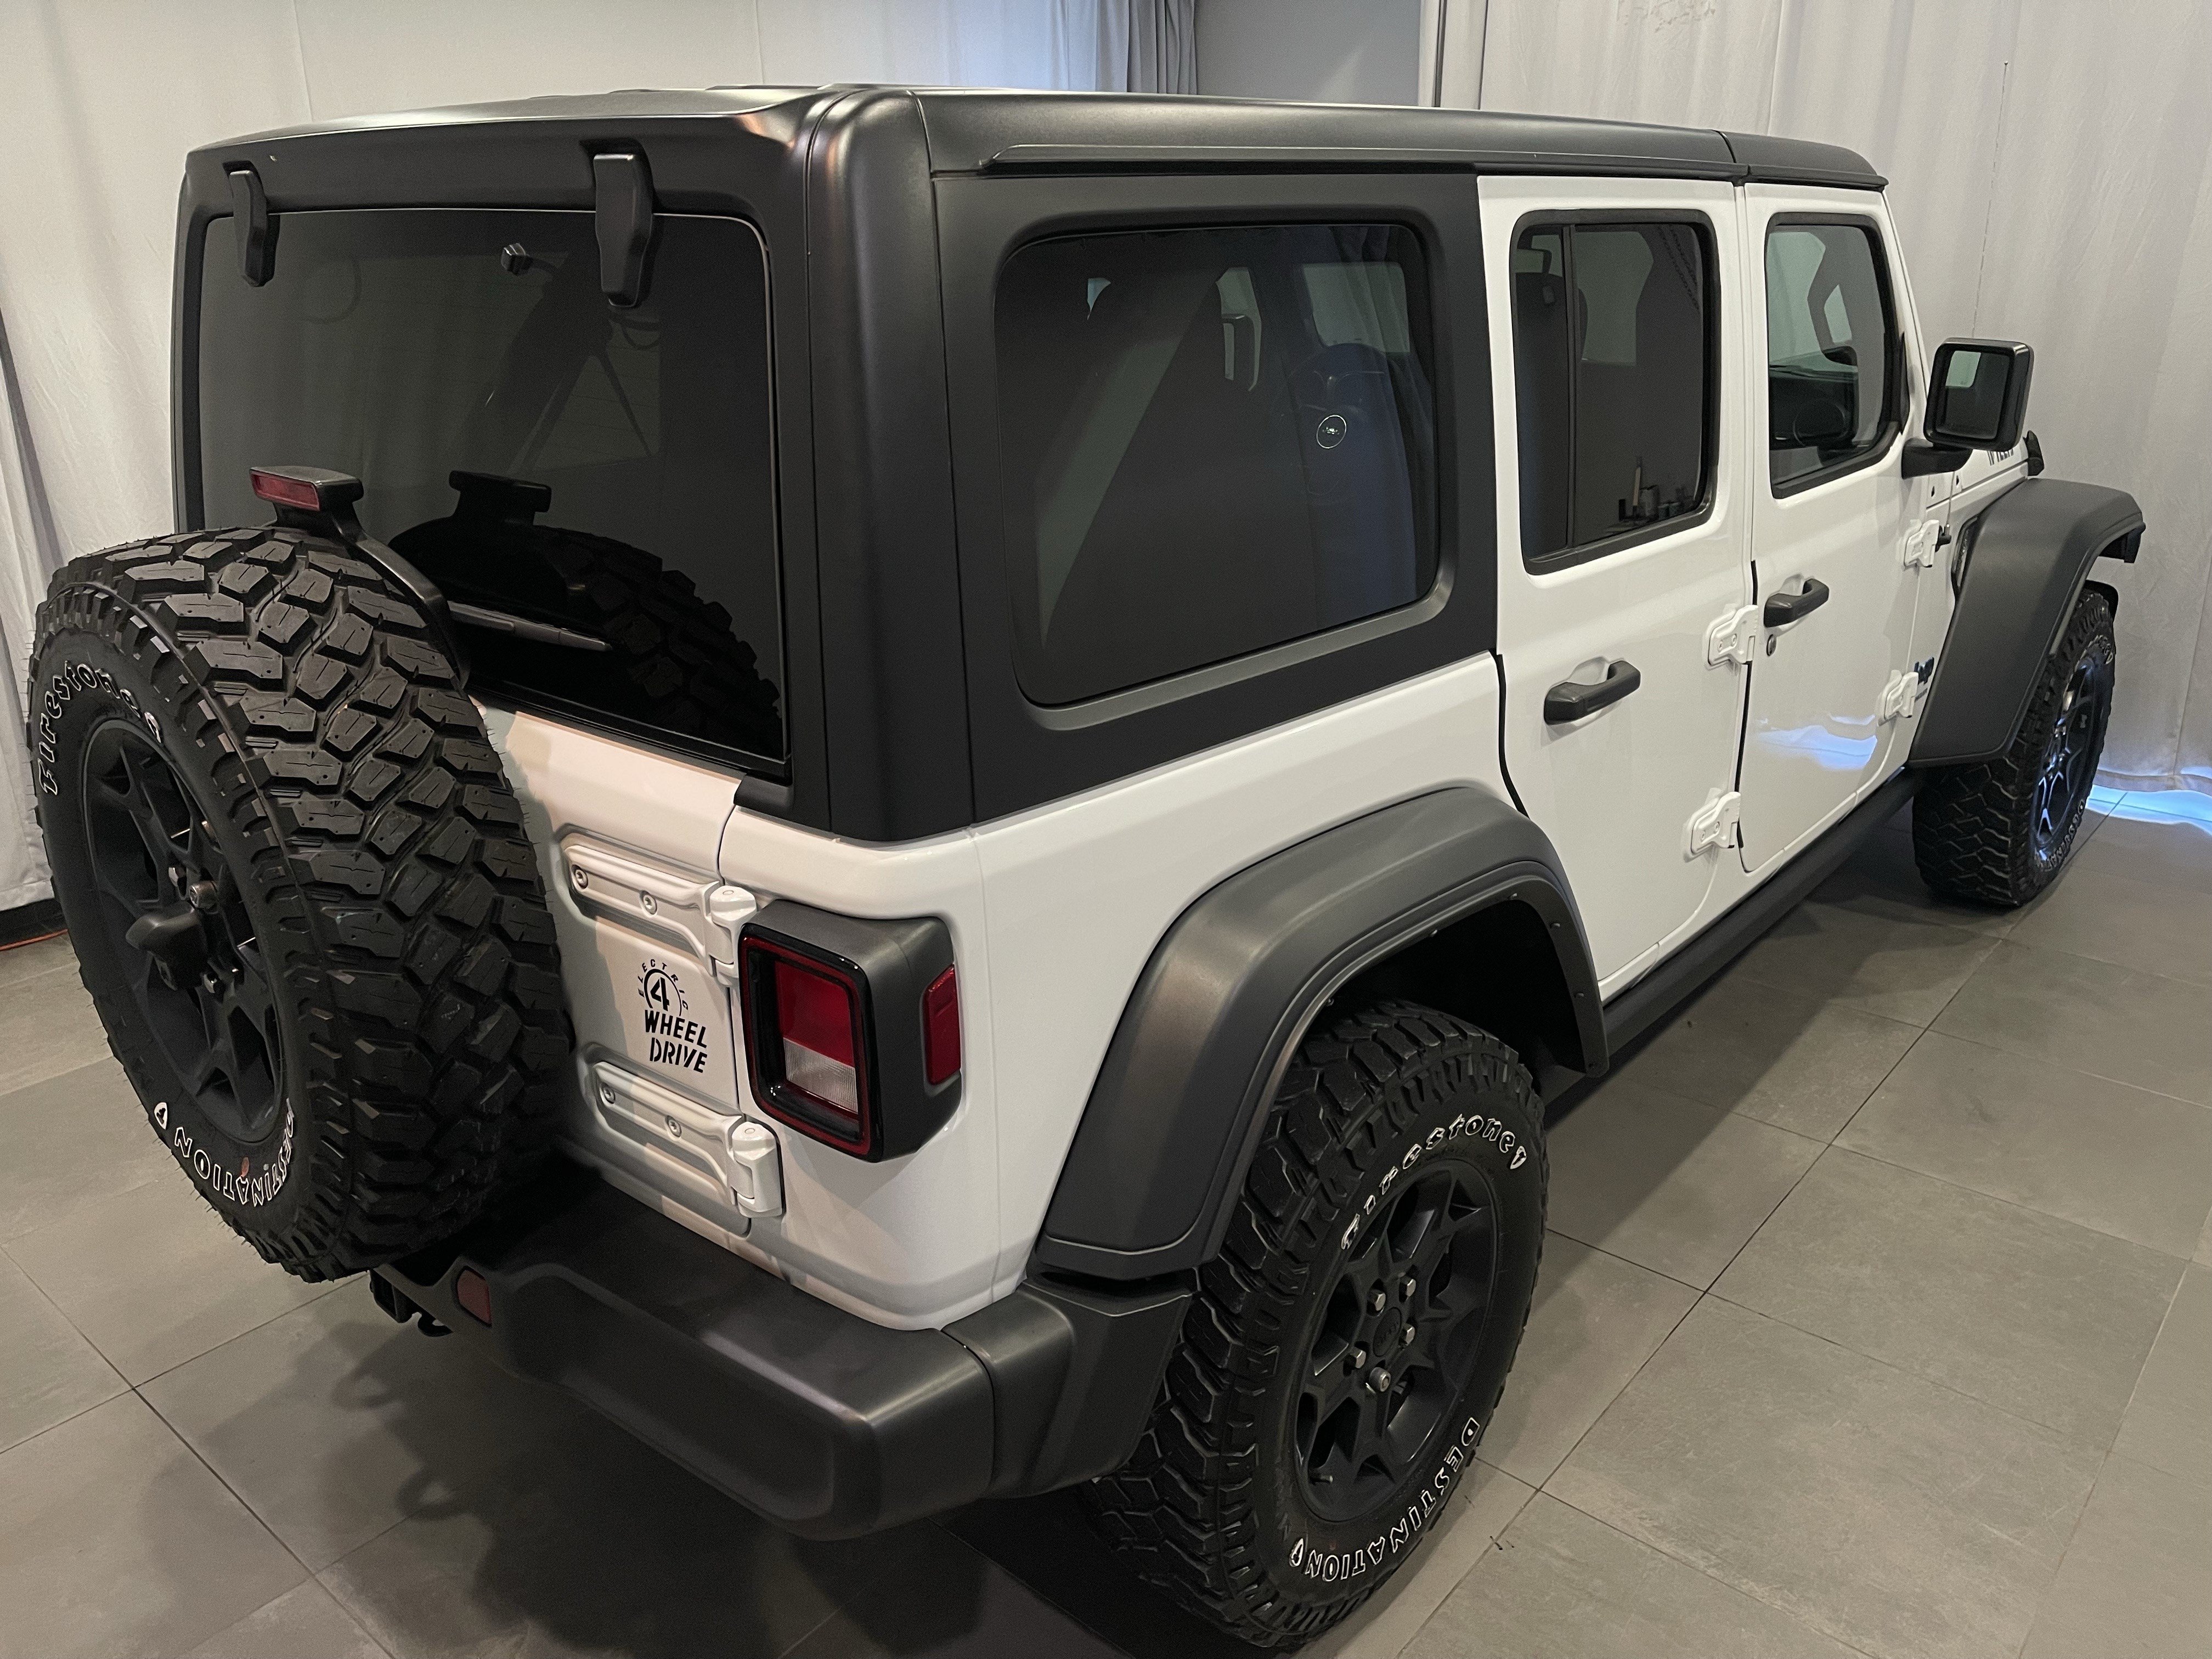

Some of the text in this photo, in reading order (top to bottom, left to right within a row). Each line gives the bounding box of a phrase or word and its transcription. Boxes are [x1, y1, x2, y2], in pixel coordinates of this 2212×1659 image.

[637, 958, 689, 1011] ELECTRIC
[650, 977, 670, 1012] 4
[645, 1009, 707, 1048] WHEEL
[649, 1037, 708, 1073] DRIVE
[1305, 1417, 1480, 1582] DESTINATION
